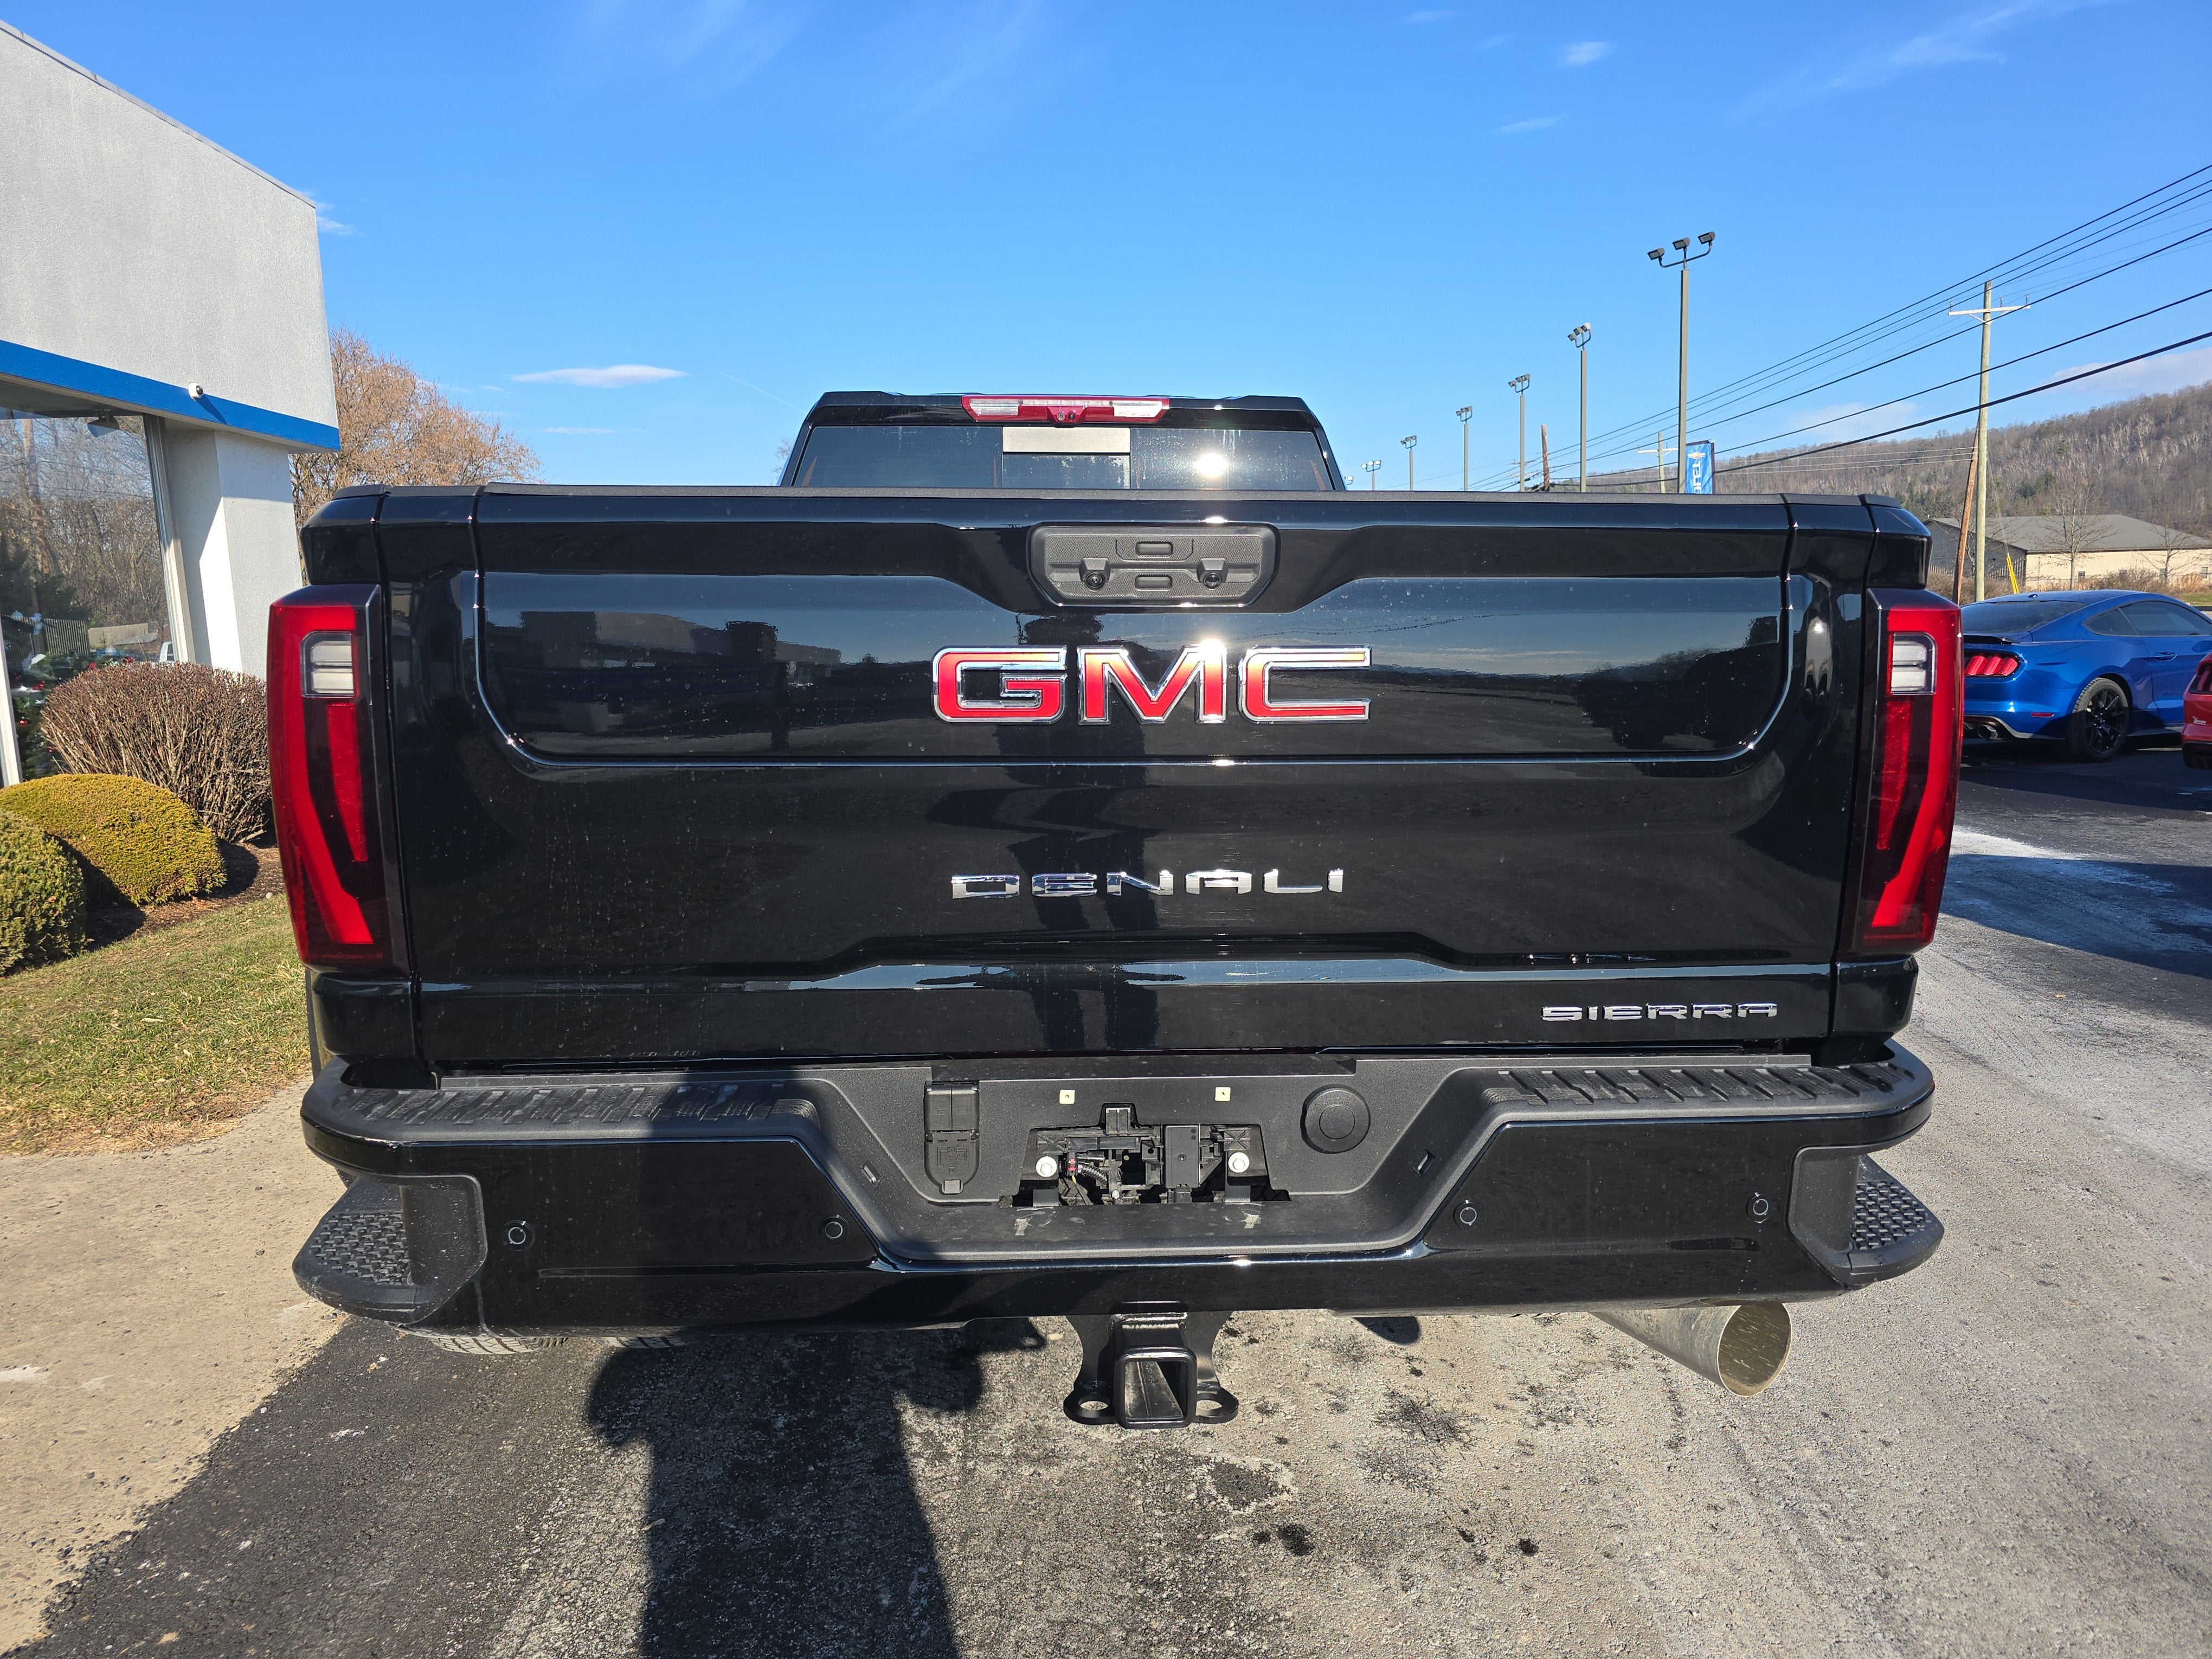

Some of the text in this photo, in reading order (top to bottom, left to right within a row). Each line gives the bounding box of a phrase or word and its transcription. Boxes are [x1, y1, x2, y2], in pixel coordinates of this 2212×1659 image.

[932, 645, 1372, 725] GMC
[951, 868, 1344, 899] DENALI
[1541, 1002, 1777, 1021] SIERRA
